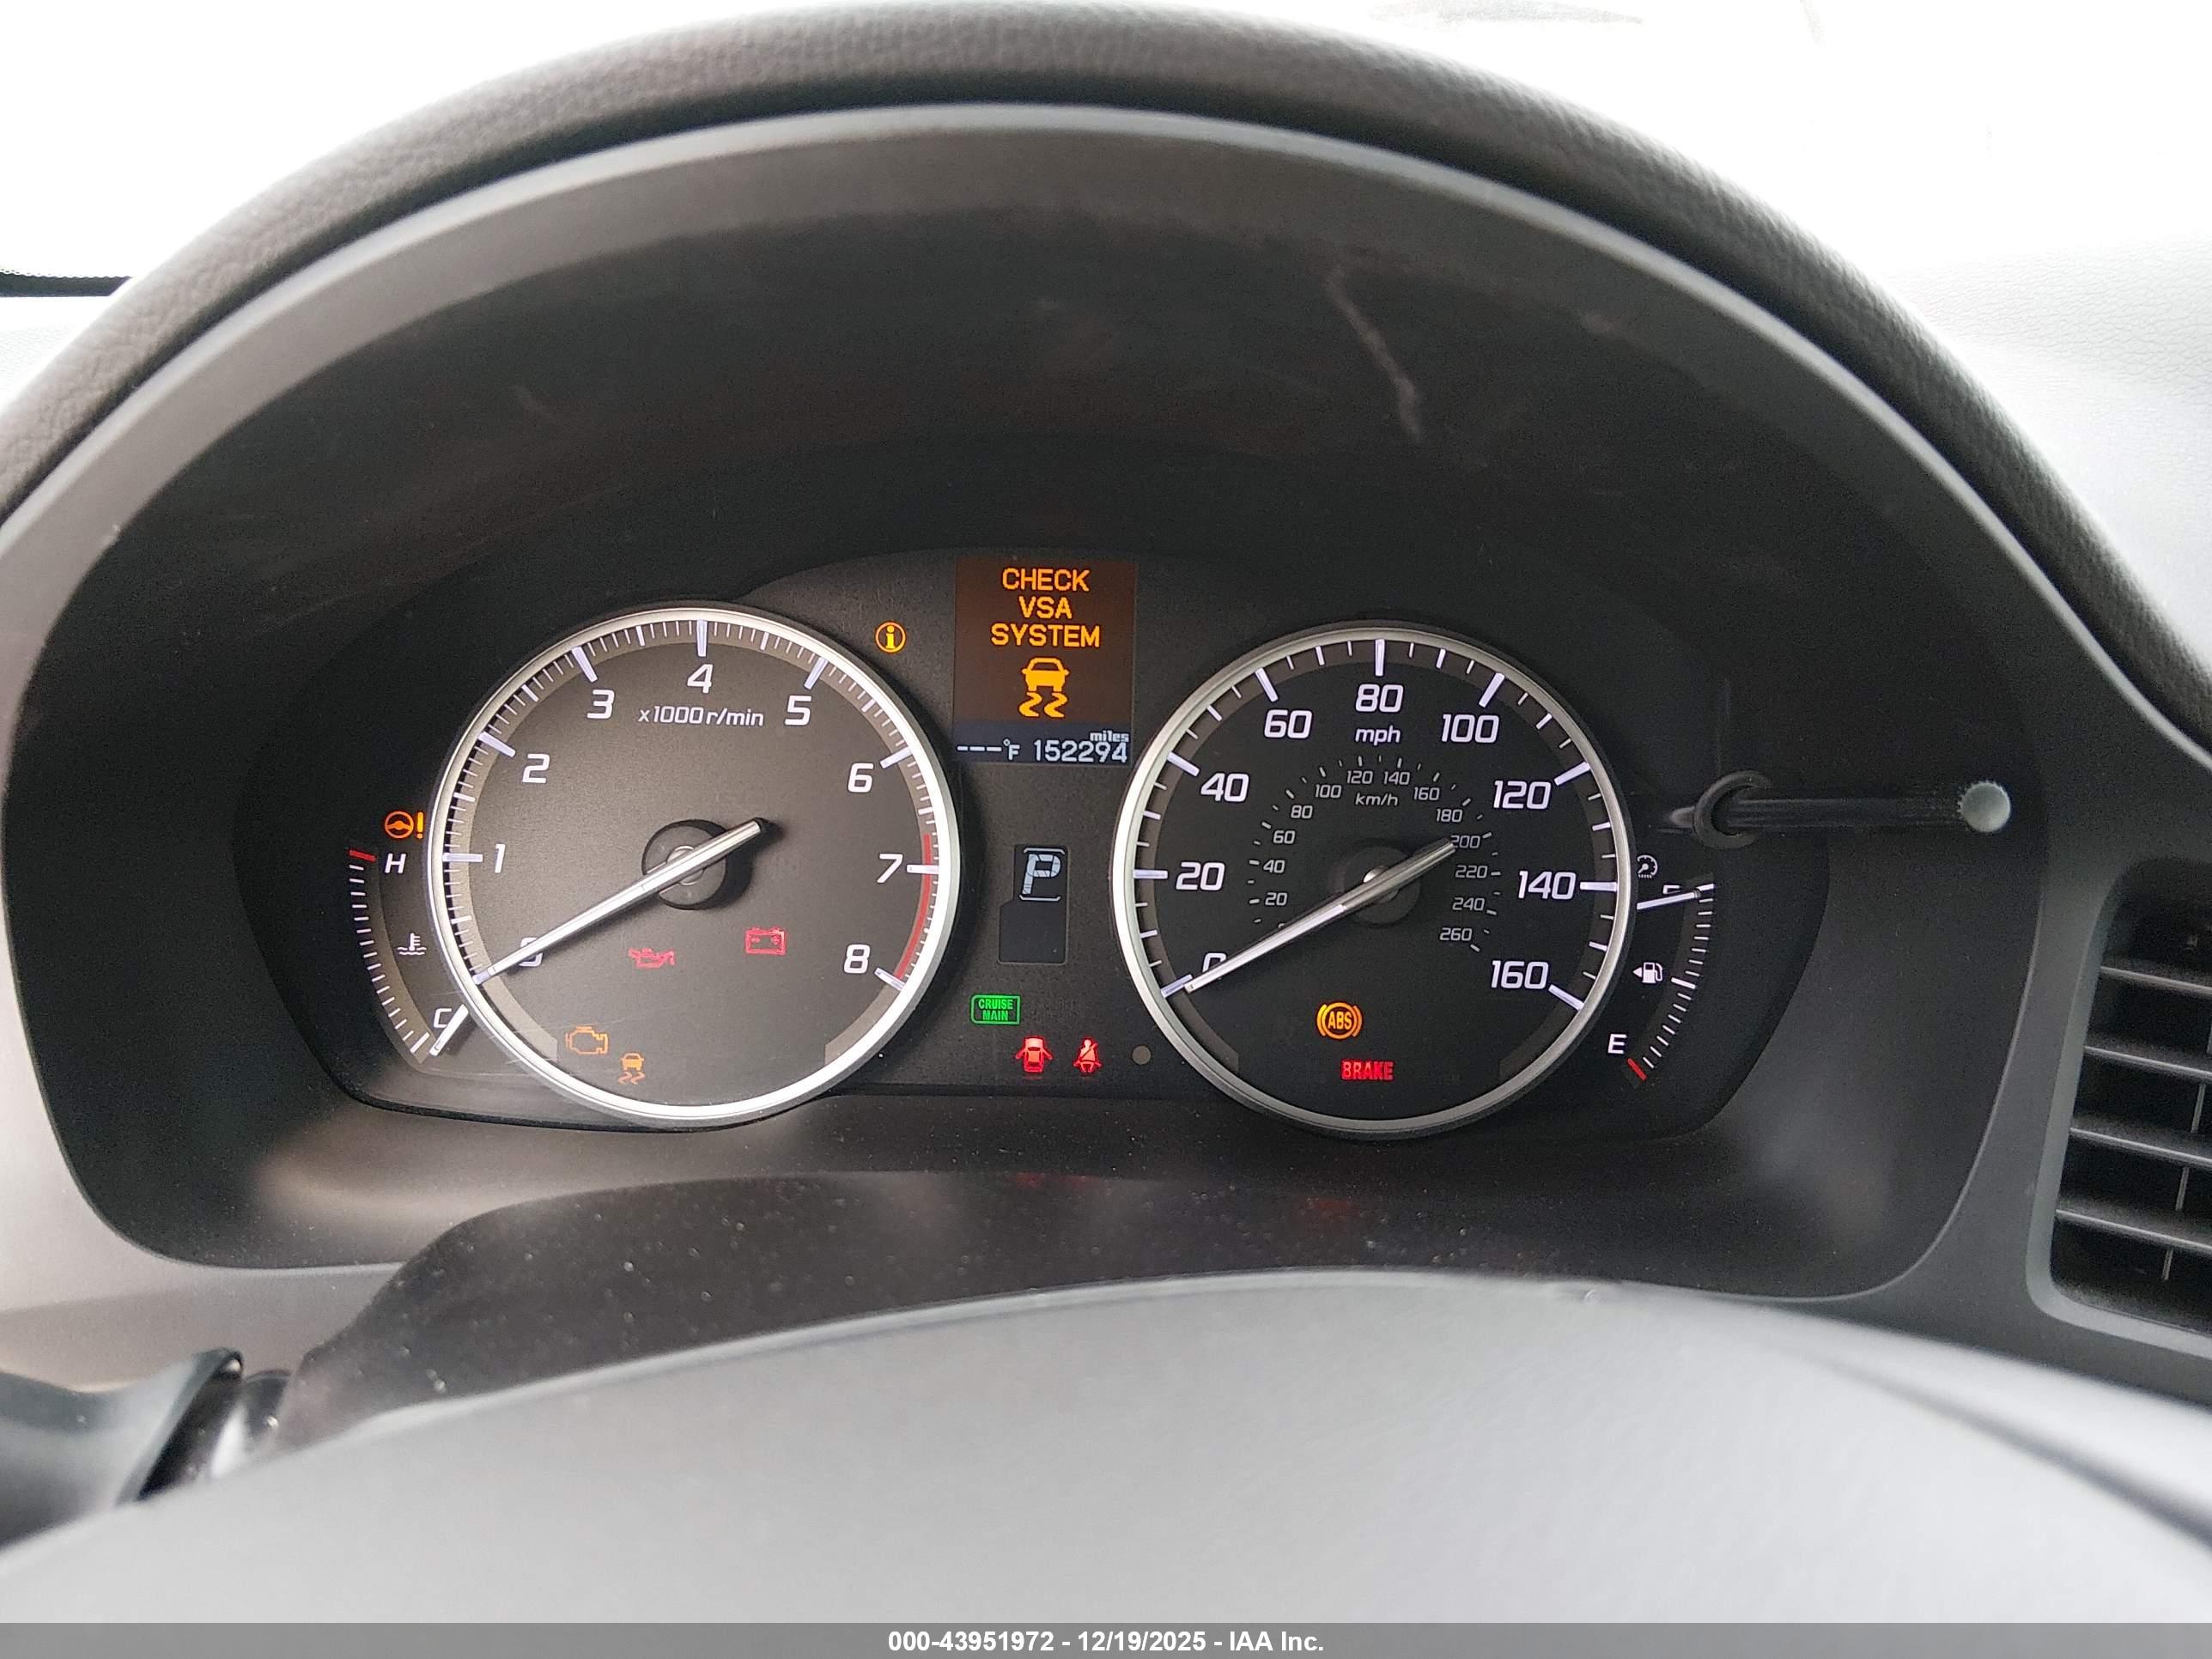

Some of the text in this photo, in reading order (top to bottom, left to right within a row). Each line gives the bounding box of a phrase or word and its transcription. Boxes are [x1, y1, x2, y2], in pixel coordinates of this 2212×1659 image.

[1002, 568, 1091, 592] CHECK
[1018, 596, 1073, 619] VSA
[991, 623, 1100, 647] SYSTEM
[687, 664, 714, 694] 4
[587, 690, 615, 720] 3
[1354, 684, 1404, 714] 80
[785, 695, 811, 726] 5
[1264, 709, 1313, 740] 60
[1440, 714, 1500, 744] 100
[1090, 731, 1129, 742] miles
[1354, 725, 1401, 747] mph
[1034, 739, 1127, 763] 152294
[521, 753, 551, 783] 2
[848, 763, 874, 793] 6
[1346, 770, 1373, 784] 120
[1383, 771, 1410, 785] 140
[1200, 773, 1249, 803] 40
[1315, 784, 1341, 798] 100
[1413, 787, 1440, 801] 160
[1492, 780, 1551, 811] 120
[1355, 793, 1398, 806] km/h
[1291, 805, 1313, 819] 80
[1436, 808, 1462, 823] 180
[1273, 830, 1295, 844] 60
[1451, 835, 1480, 849] 200
[385, 853, 406, 873] H
[495, 843, 506, 873] 1
[876, 854, 904, 884] 7
[1263, 860, 1285, 873] 40
[1022, 854, 1061, 895] P
[1175, 861, 1225, 891] 20
[1455, 866, 1488, 878] 220
[1516, 871, 1577, 901] 140
[1265, 892, 1287, 906] 20
[1452, 897, 1485, 911] 240
[1439, 927, 1473, 941] 260
[843, 944, 871, 974] 8
[1490, 959, 1549, 990] 160
[978, 999, 1013, 1011] CRUISE
[982, 1010, 1008, 1021] MAIN
[1328, 1011, 1352, 1030] ABS
[1607, 1034, 1626, 1054] E
[1341, 1060, 1394, 1080] BRAKE
